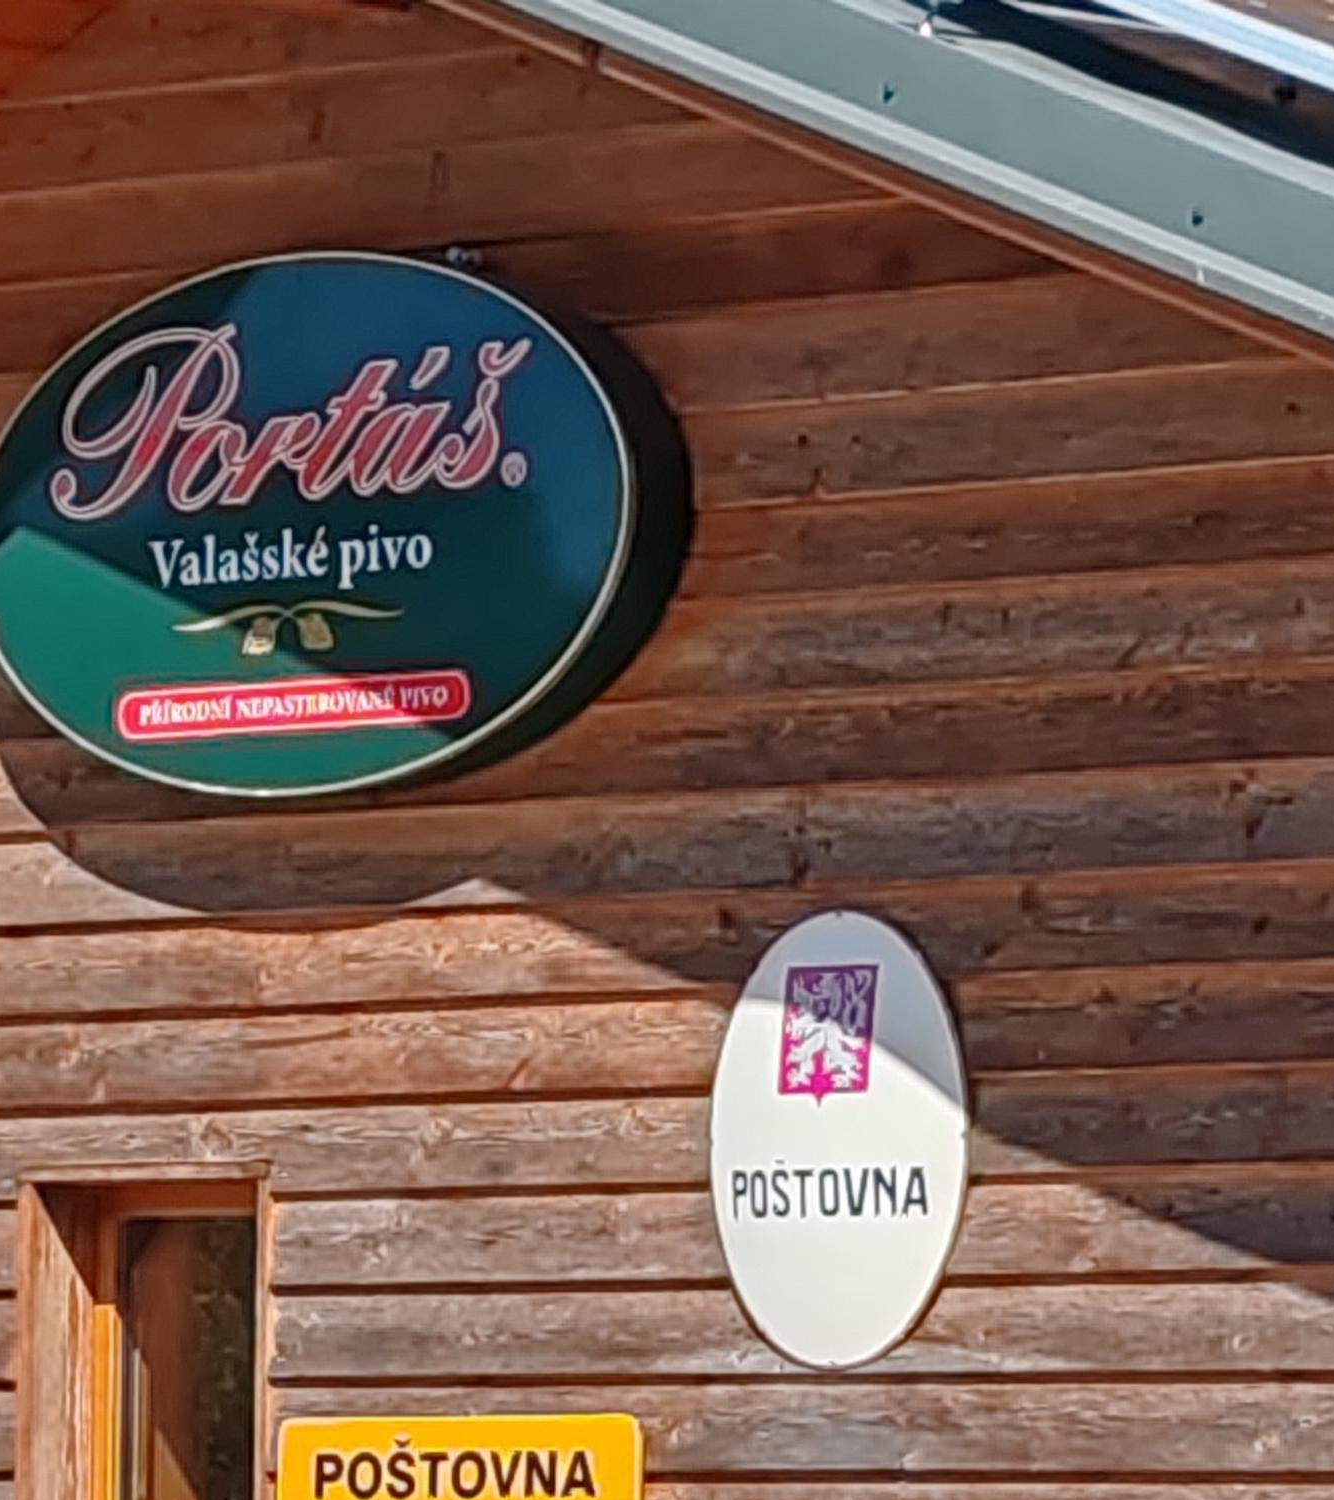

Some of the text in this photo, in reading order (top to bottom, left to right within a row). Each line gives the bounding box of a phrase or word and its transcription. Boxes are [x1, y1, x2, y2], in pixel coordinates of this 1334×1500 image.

[50, 323, 533, 520] Portáš
[147, 524, 434, 590] Valašské pivo
[138, 694, 231, 726] PŘÍRODNÍ
[732, 1159, 929, 1221] POŠTOVNA
[314, 1439, 596, 1499] POŠTOVNA
